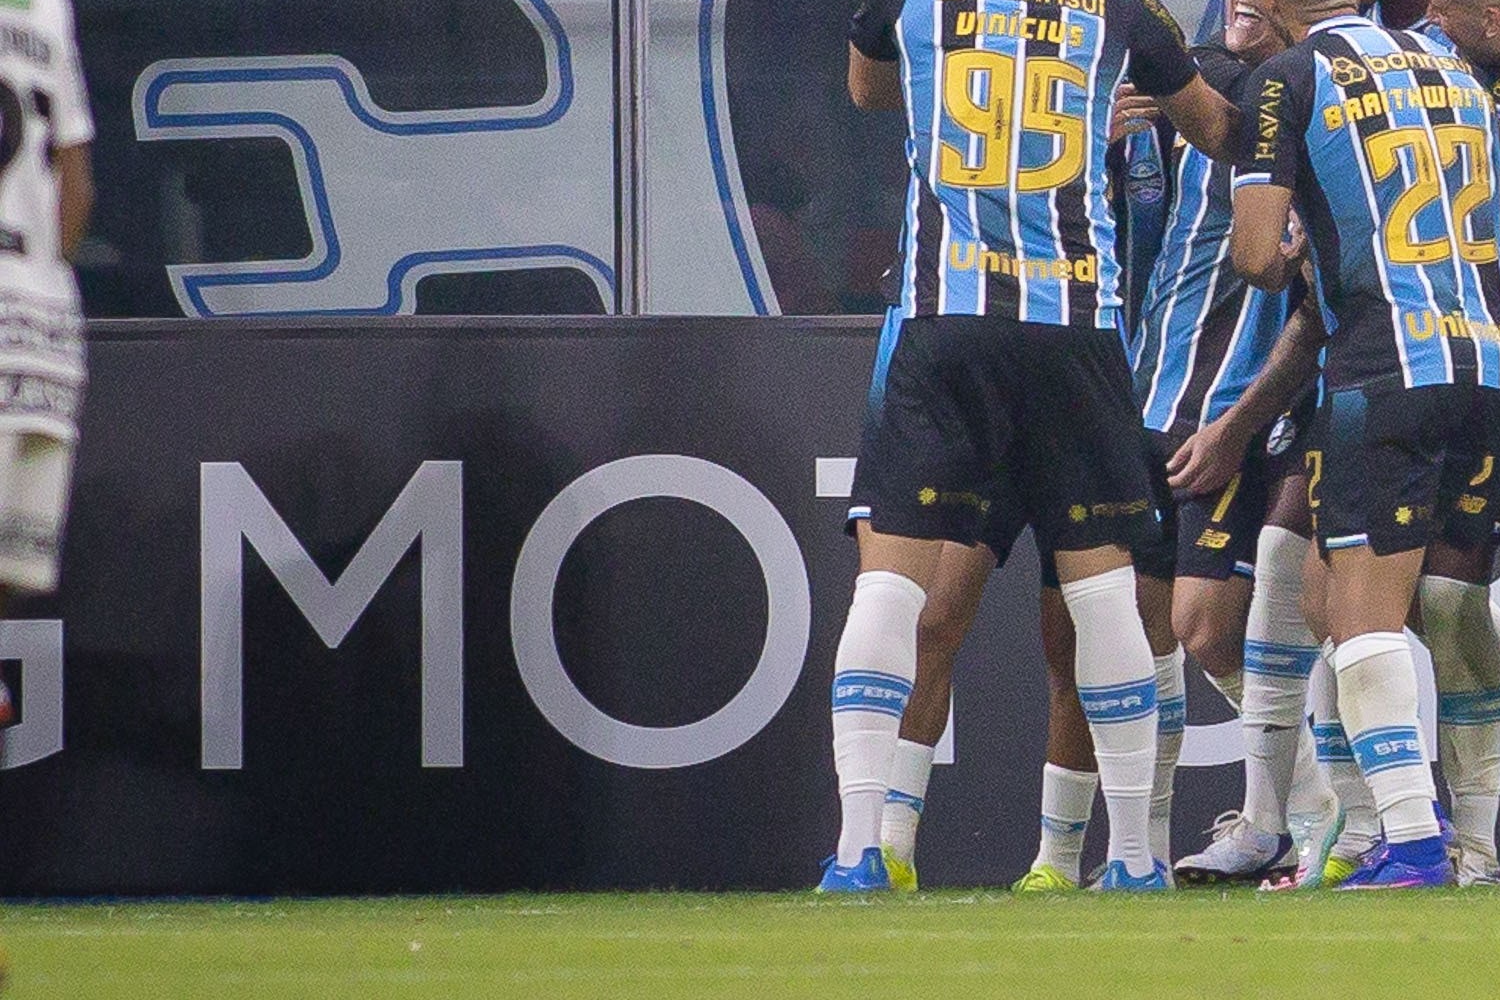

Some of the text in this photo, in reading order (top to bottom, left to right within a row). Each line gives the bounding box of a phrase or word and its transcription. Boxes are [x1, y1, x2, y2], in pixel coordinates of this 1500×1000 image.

[938, 48, 1089, 192] 95
[1254, 78, 1285, 161] HAVAN
[1364, 123, 1500, 265] 22
[951, 241, 1097, 283] Unimed
